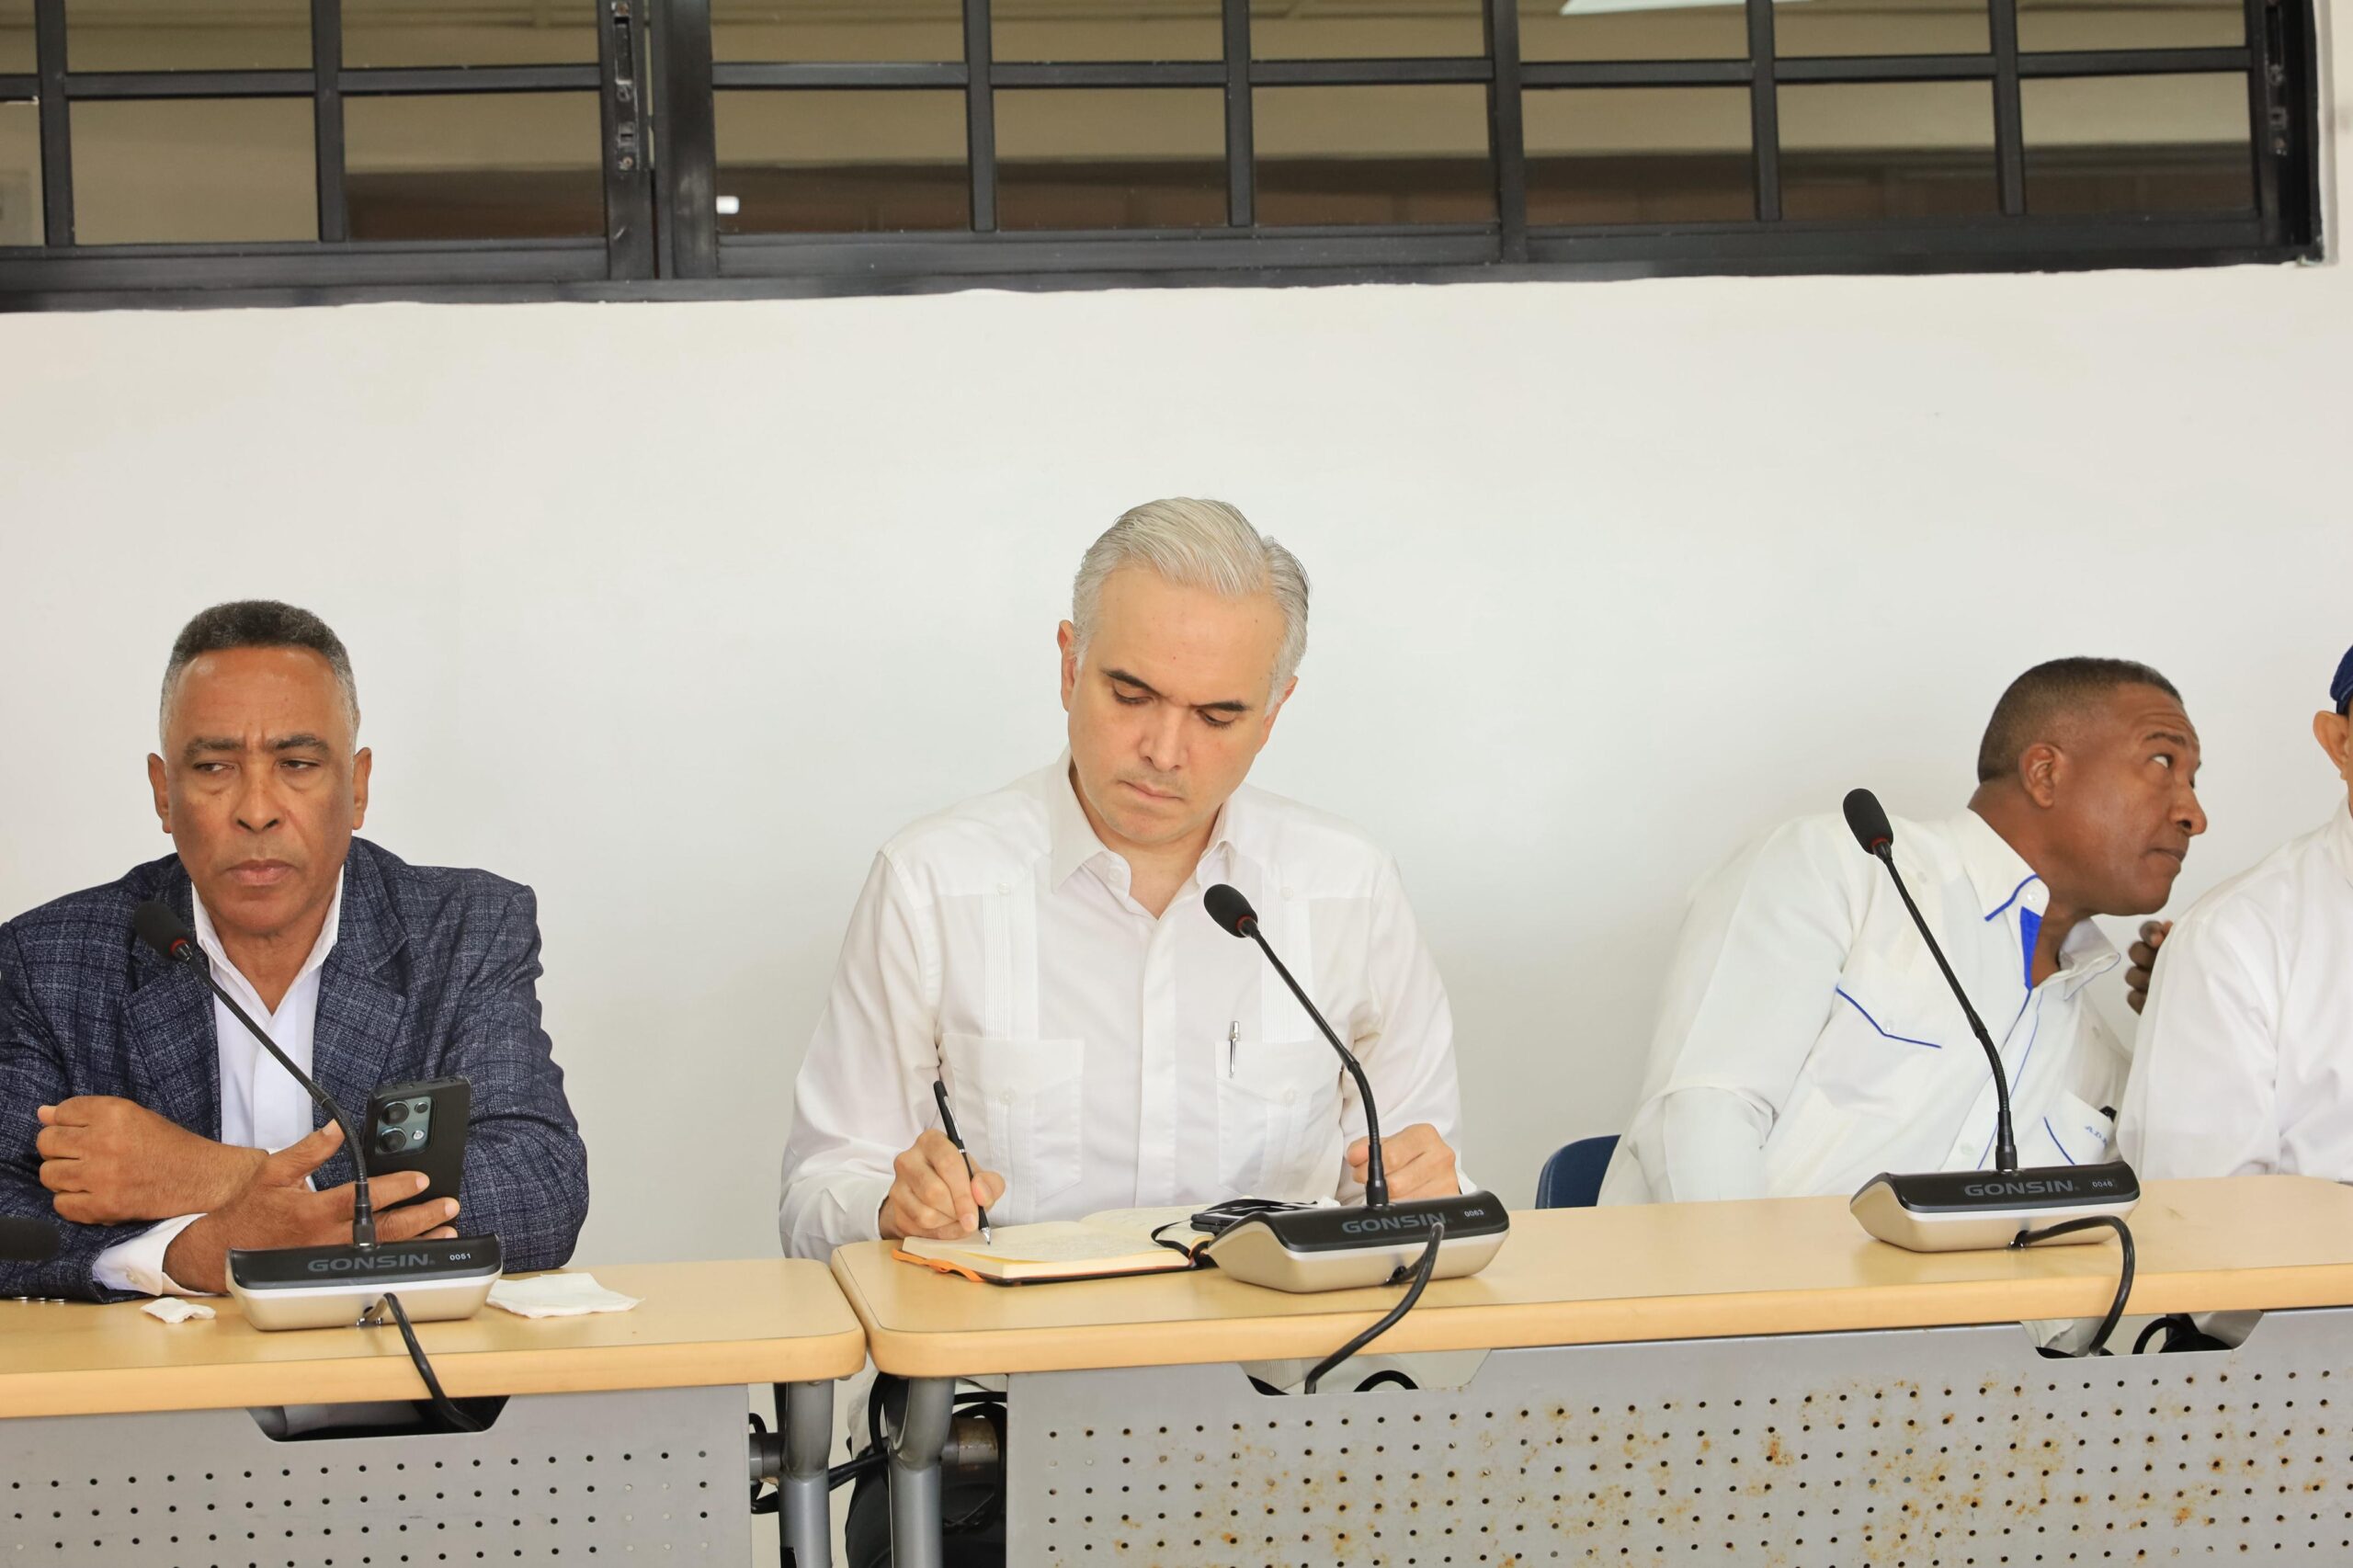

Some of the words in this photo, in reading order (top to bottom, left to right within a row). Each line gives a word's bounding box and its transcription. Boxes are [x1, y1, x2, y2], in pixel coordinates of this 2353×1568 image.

[1963, 1179, 2074, 1197] GONSIN
[1342, 1212, 1447, 1233] GONSIN
[307, 1253, 428, 1272] GONSIN
[449, 1253, 471, 1261] 0051
